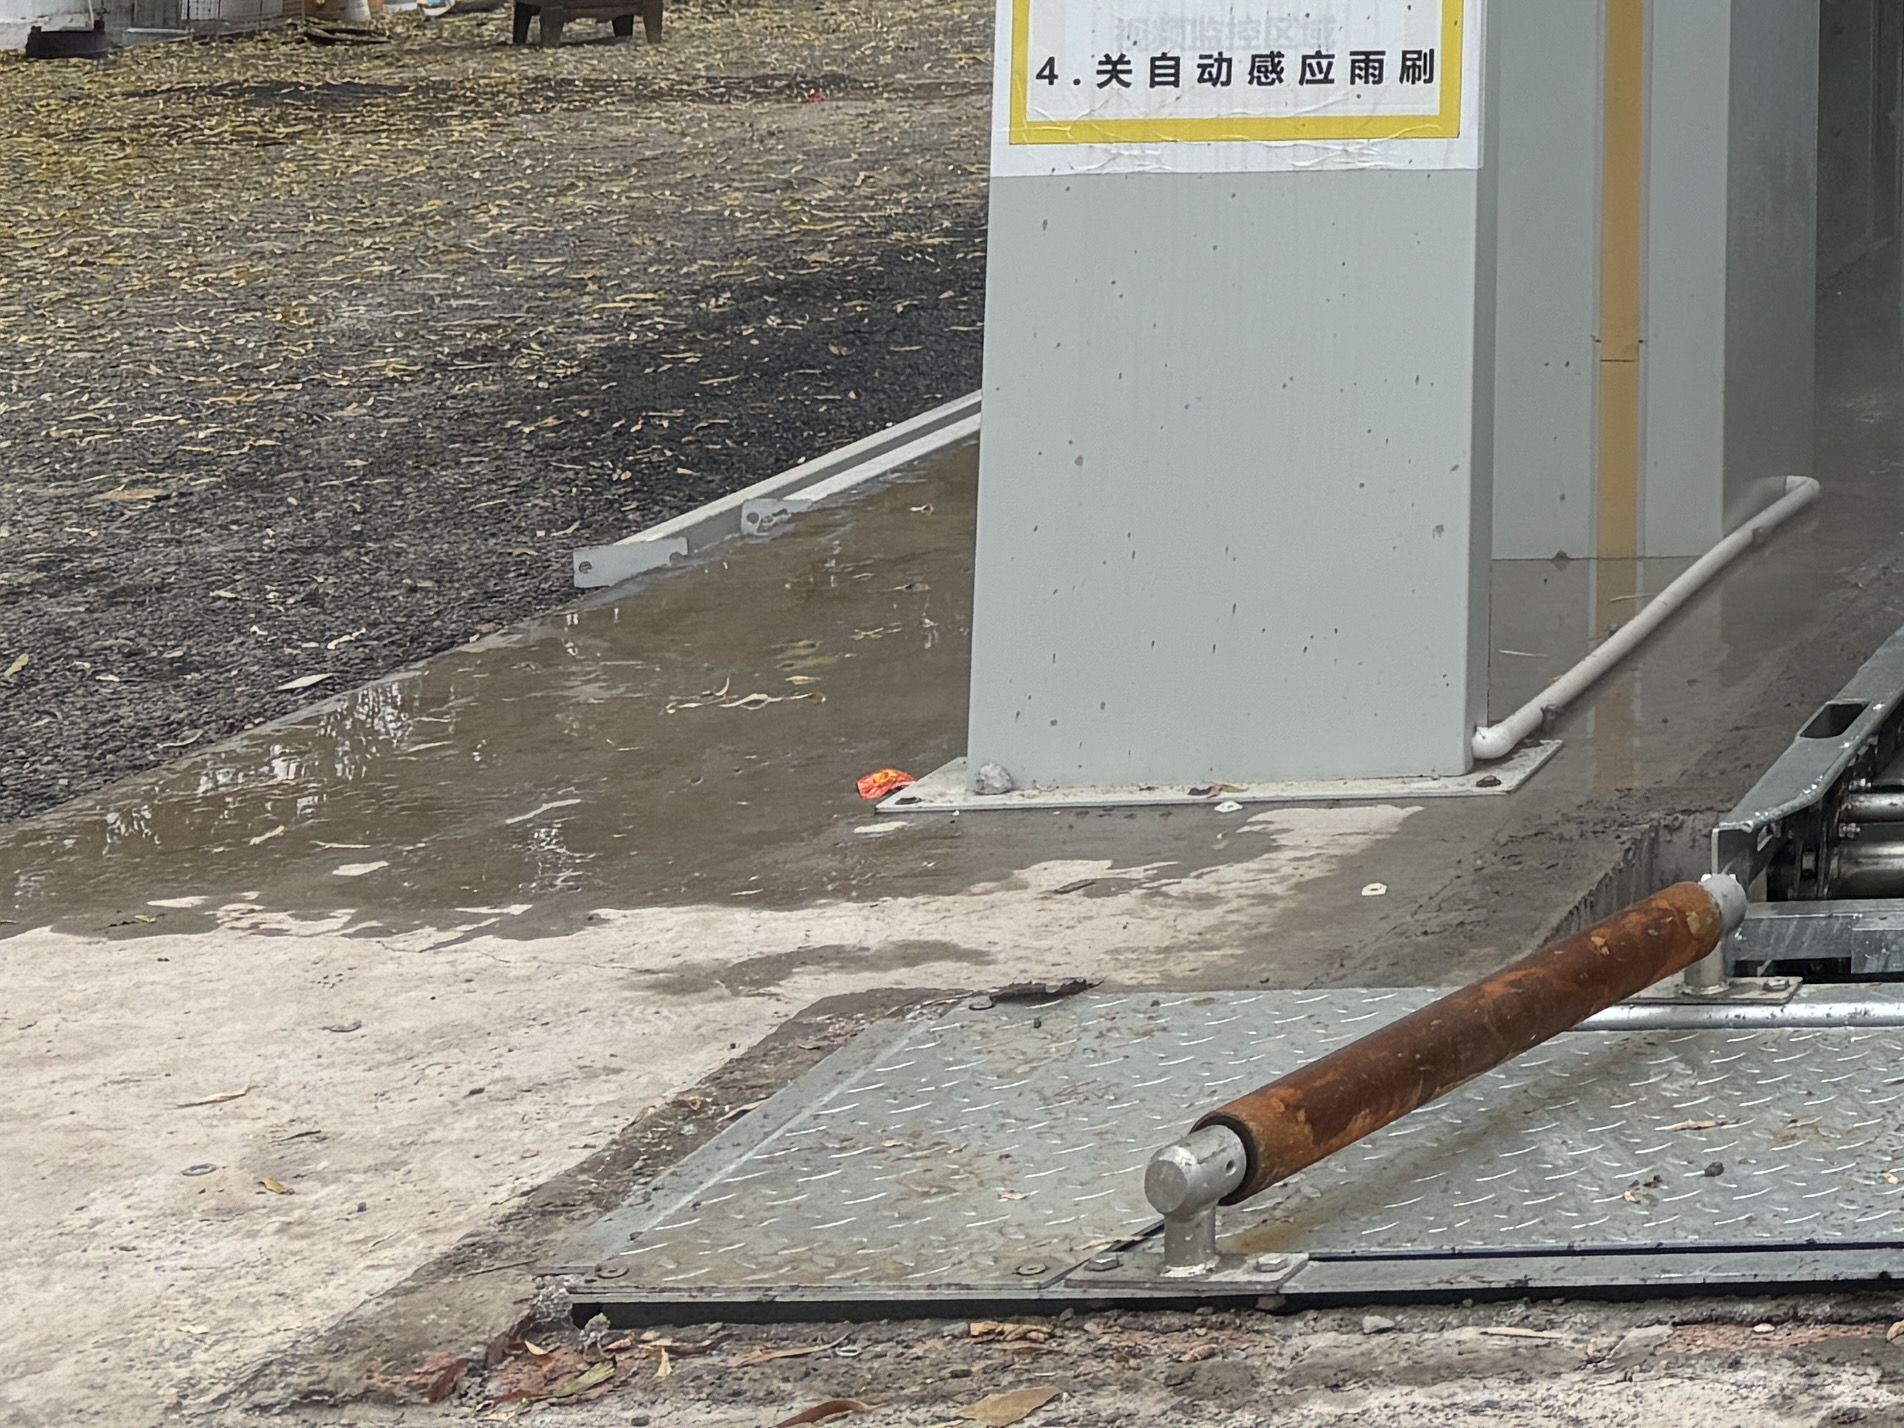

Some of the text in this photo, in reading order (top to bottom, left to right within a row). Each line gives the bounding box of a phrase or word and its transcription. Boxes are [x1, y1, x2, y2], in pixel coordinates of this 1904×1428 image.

[1035, 48, 1435, 89] 4.关自动感应雨刷
